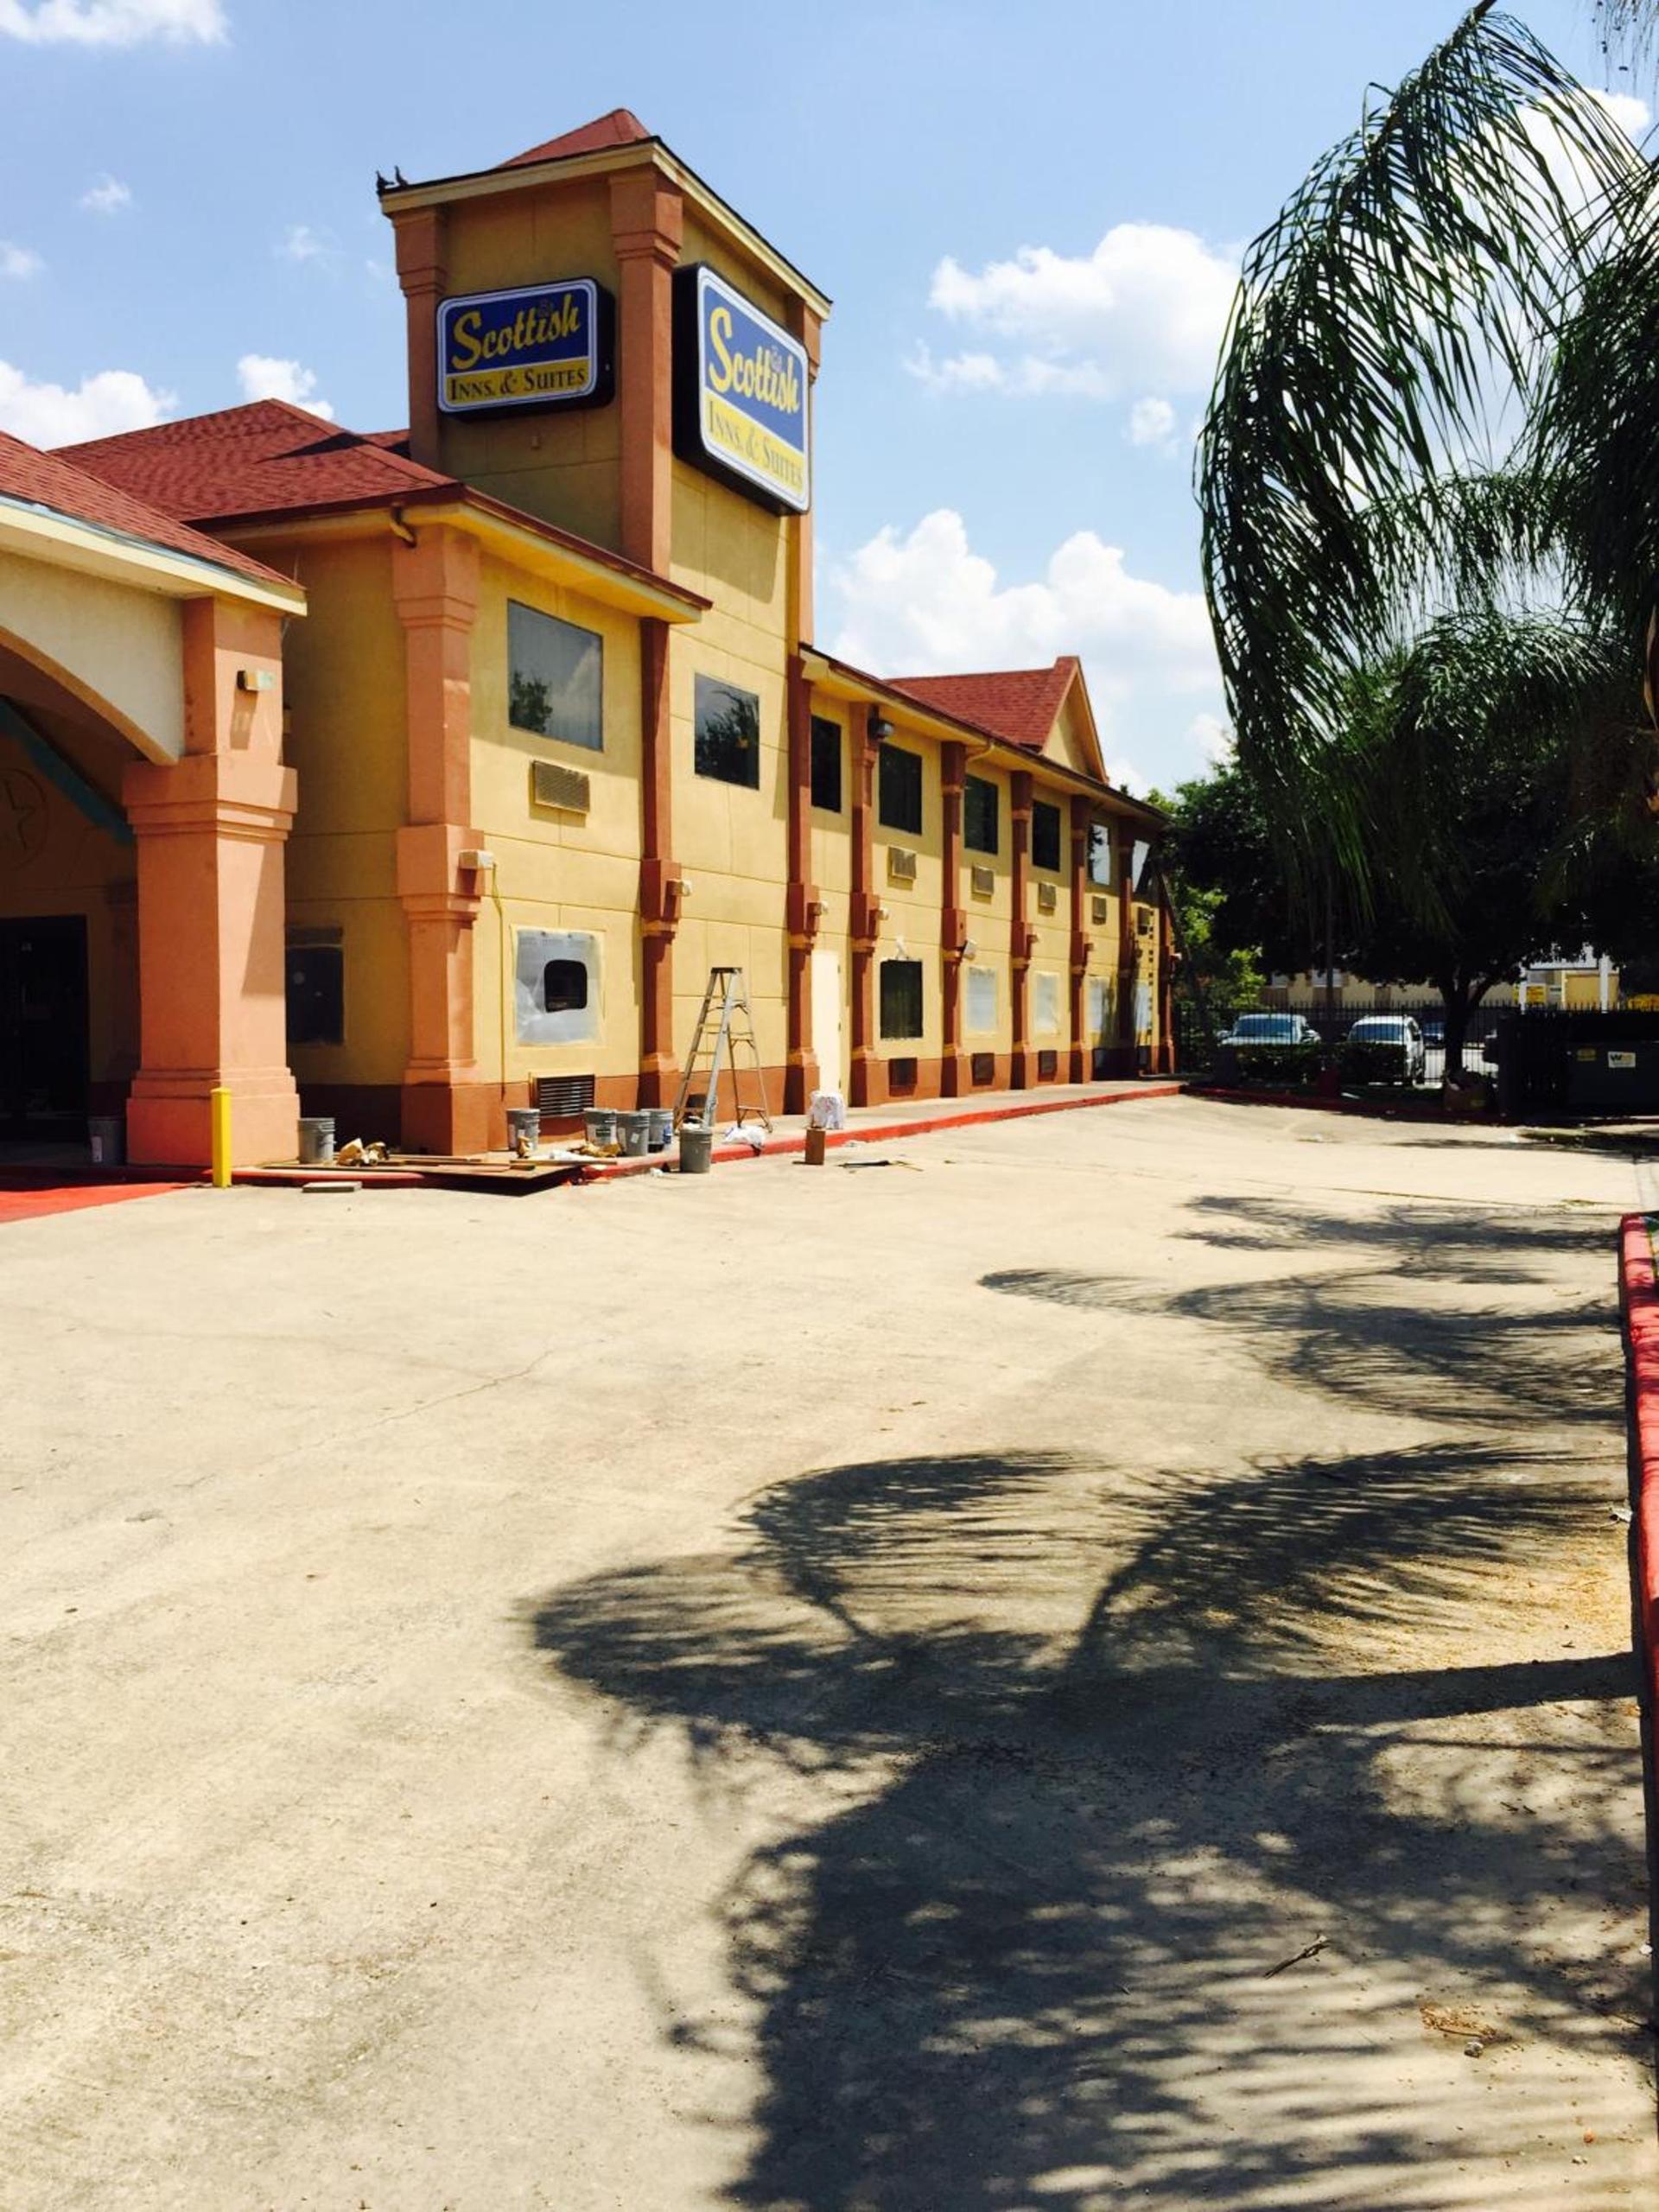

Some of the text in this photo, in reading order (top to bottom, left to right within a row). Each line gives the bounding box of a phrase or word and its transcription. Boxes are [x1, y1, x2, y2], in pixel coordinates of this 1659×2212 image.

[451, 293, 581, 370] Scottish
[709, 307, 800, 414] Scottish
[500, 371, 518, 394] &
[524, 368, 585, 391] SUITES
[763, 438, 803, 486] SUITES
